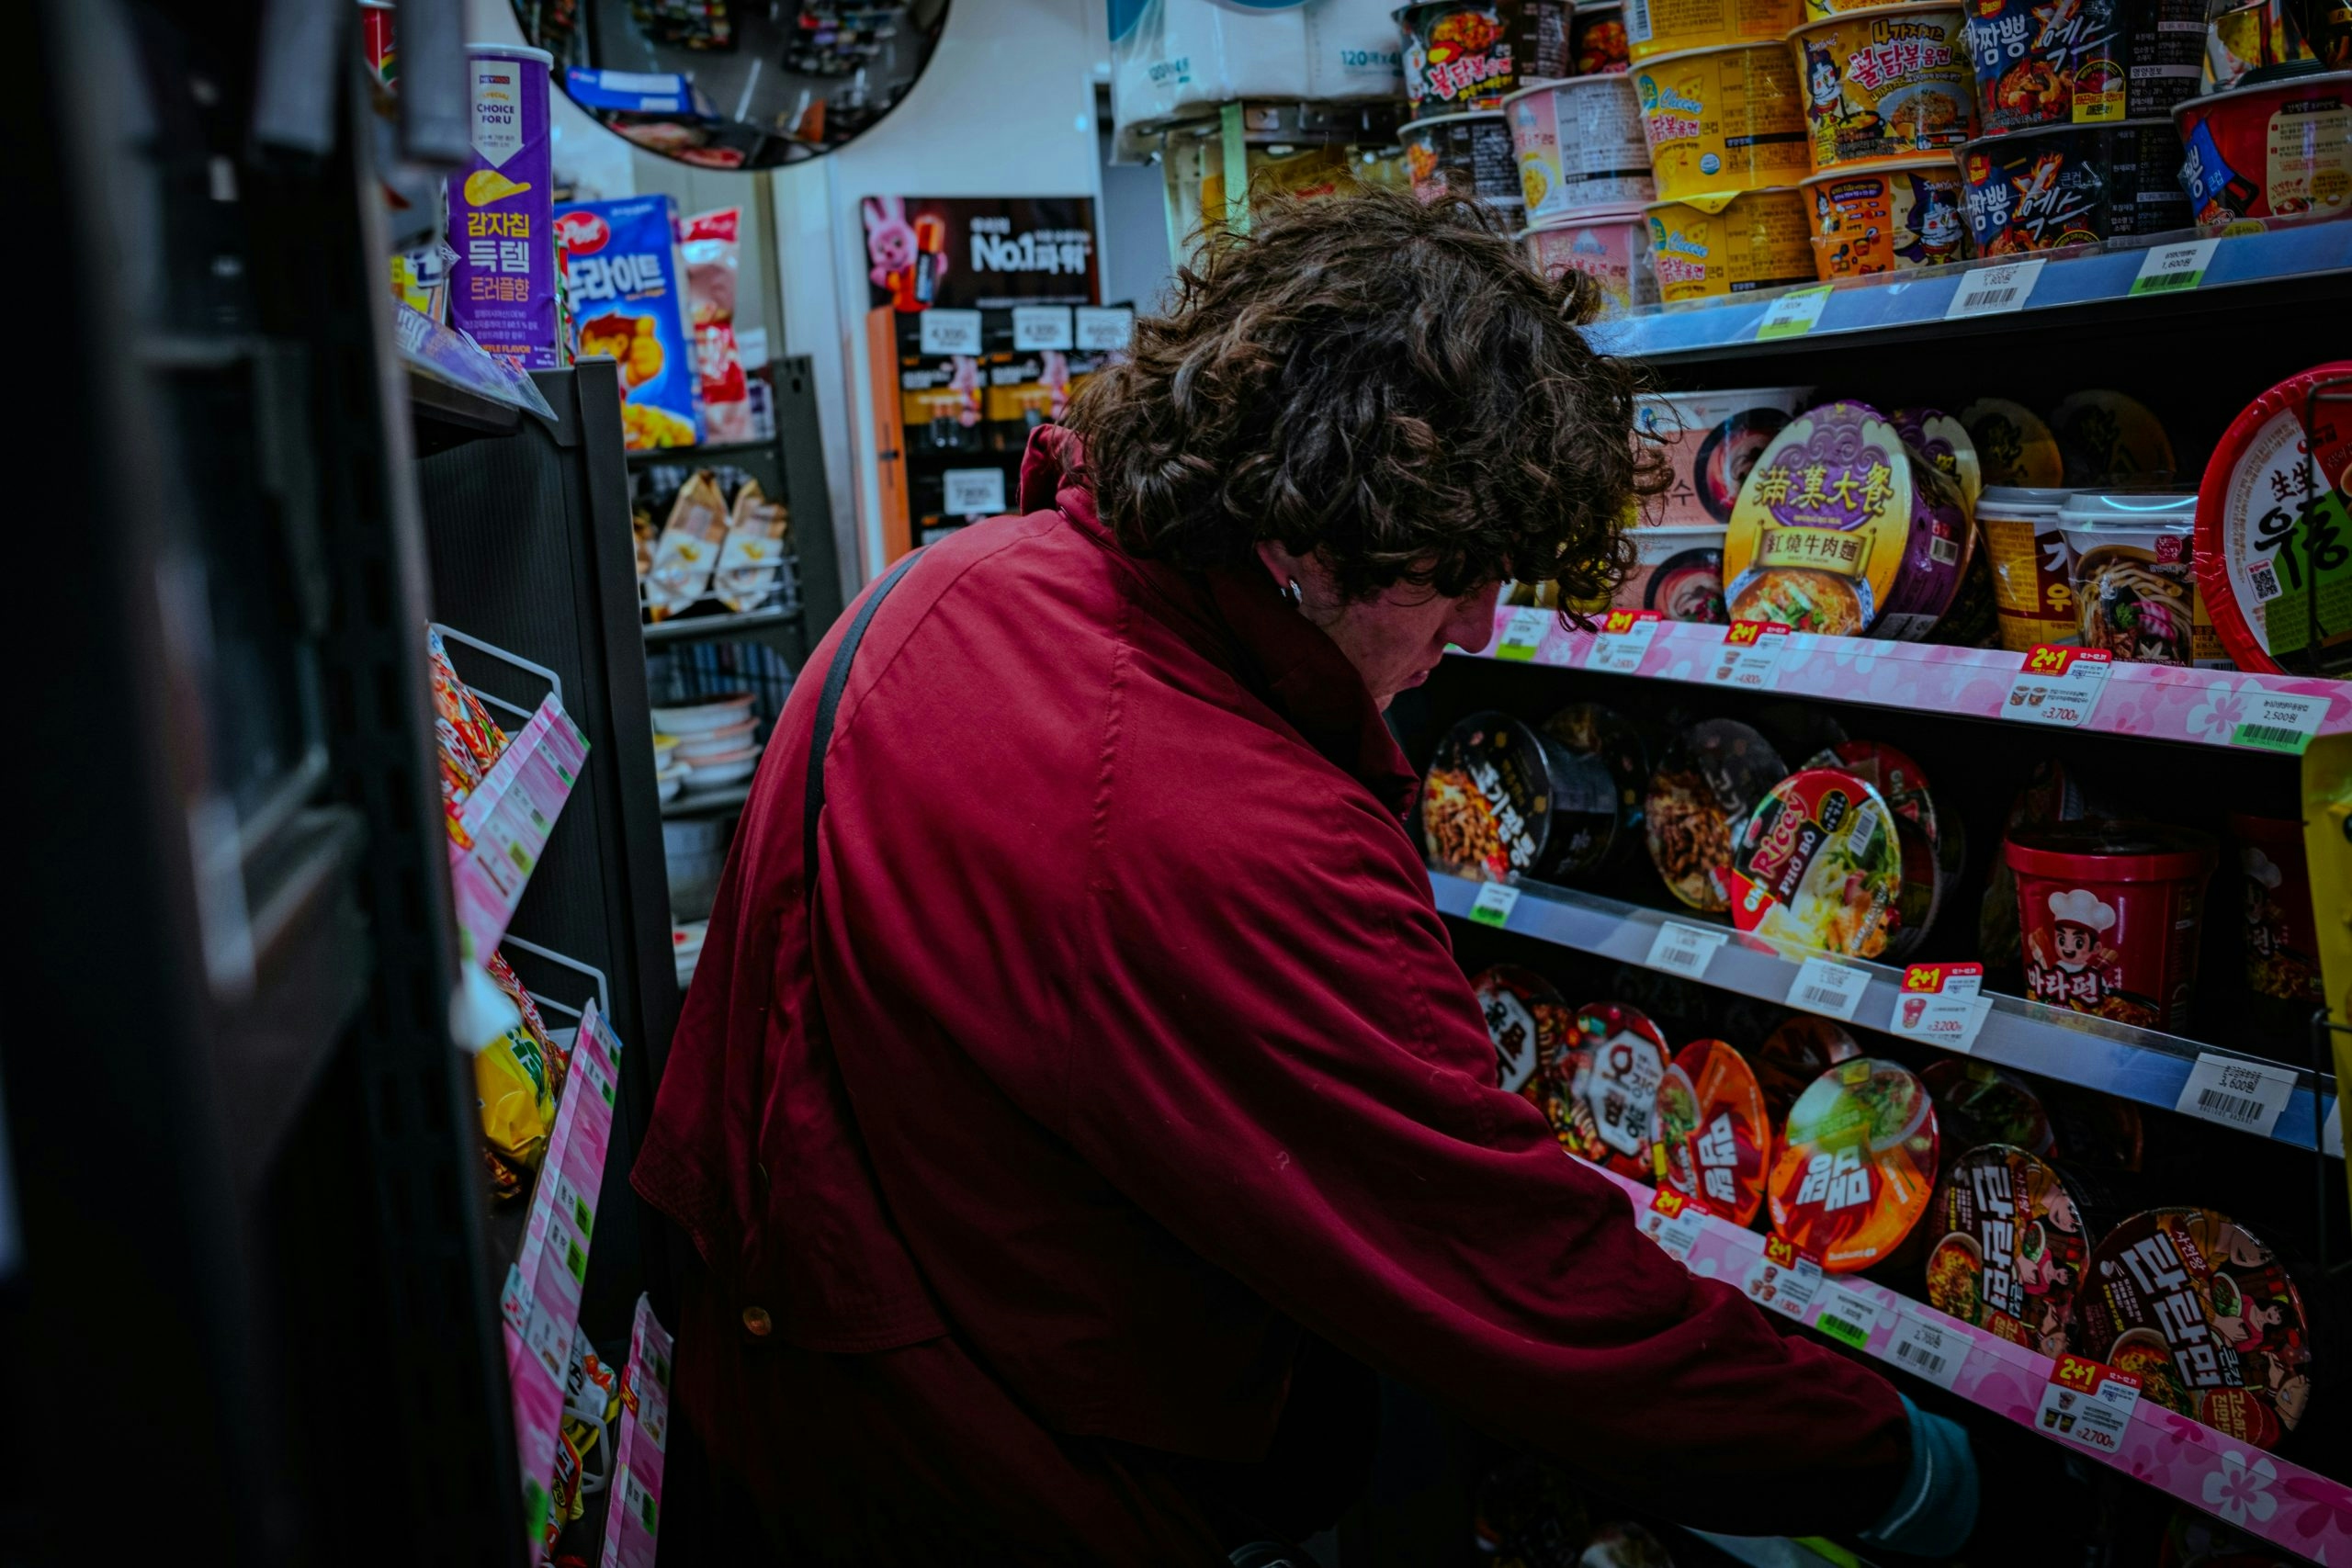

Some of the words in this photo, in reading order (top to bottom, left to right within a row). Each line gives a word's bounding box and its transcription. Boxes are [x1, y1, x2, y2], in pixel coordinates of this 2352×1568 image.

[1978, 15, 2029, 65] 짬뽕
[1849, 44, 1952, 91] 불닭볶음면
[477, 103, 514, 114] CHOICE
[1660, 87, 1703, 115] Cheese
[481, 115, 502, 124] FOR
[503, 116, 511, 124] U
[1648, 115, 1700, 144] 닭볶음면
[1969, 184, 2010, 231] 짬뽕
[467, 212, 530, 239] 감자칩
[468, 241, 530, 274] 득템
[1668, 231, 1709, 258] Cheese
[1657, 258, 1705, 283] 닭볶음면
[470, 278, 529, 302] 트러플향
[1752, 461, 1894, 515] 滿漢大餐
[2254, 495, 2350, 590] 우동
[1729, 622, 1757, 644] 2+1
[2031, 647, 2067, 670] 2+1
[1748, 791, 1810, 879] Ricey
[1743, 877, 1770, 912] Oh!
[1907, 968, 1939, 989] 2+1
[1698, 1112, 1738, 1204] 맵탱
[1795, 1145, 1872, 1213] 맵탱
[1972, 1165, 2015, 1309] 탄탄면
[2176, 1230, 2207, 1270] 사천왕
[2119, 1232, 2222, 1387] 탄탄면
[2058, 1358, 2096, 1385] 2+1
[2218, 1345, 2243, 1386] 큰컵
